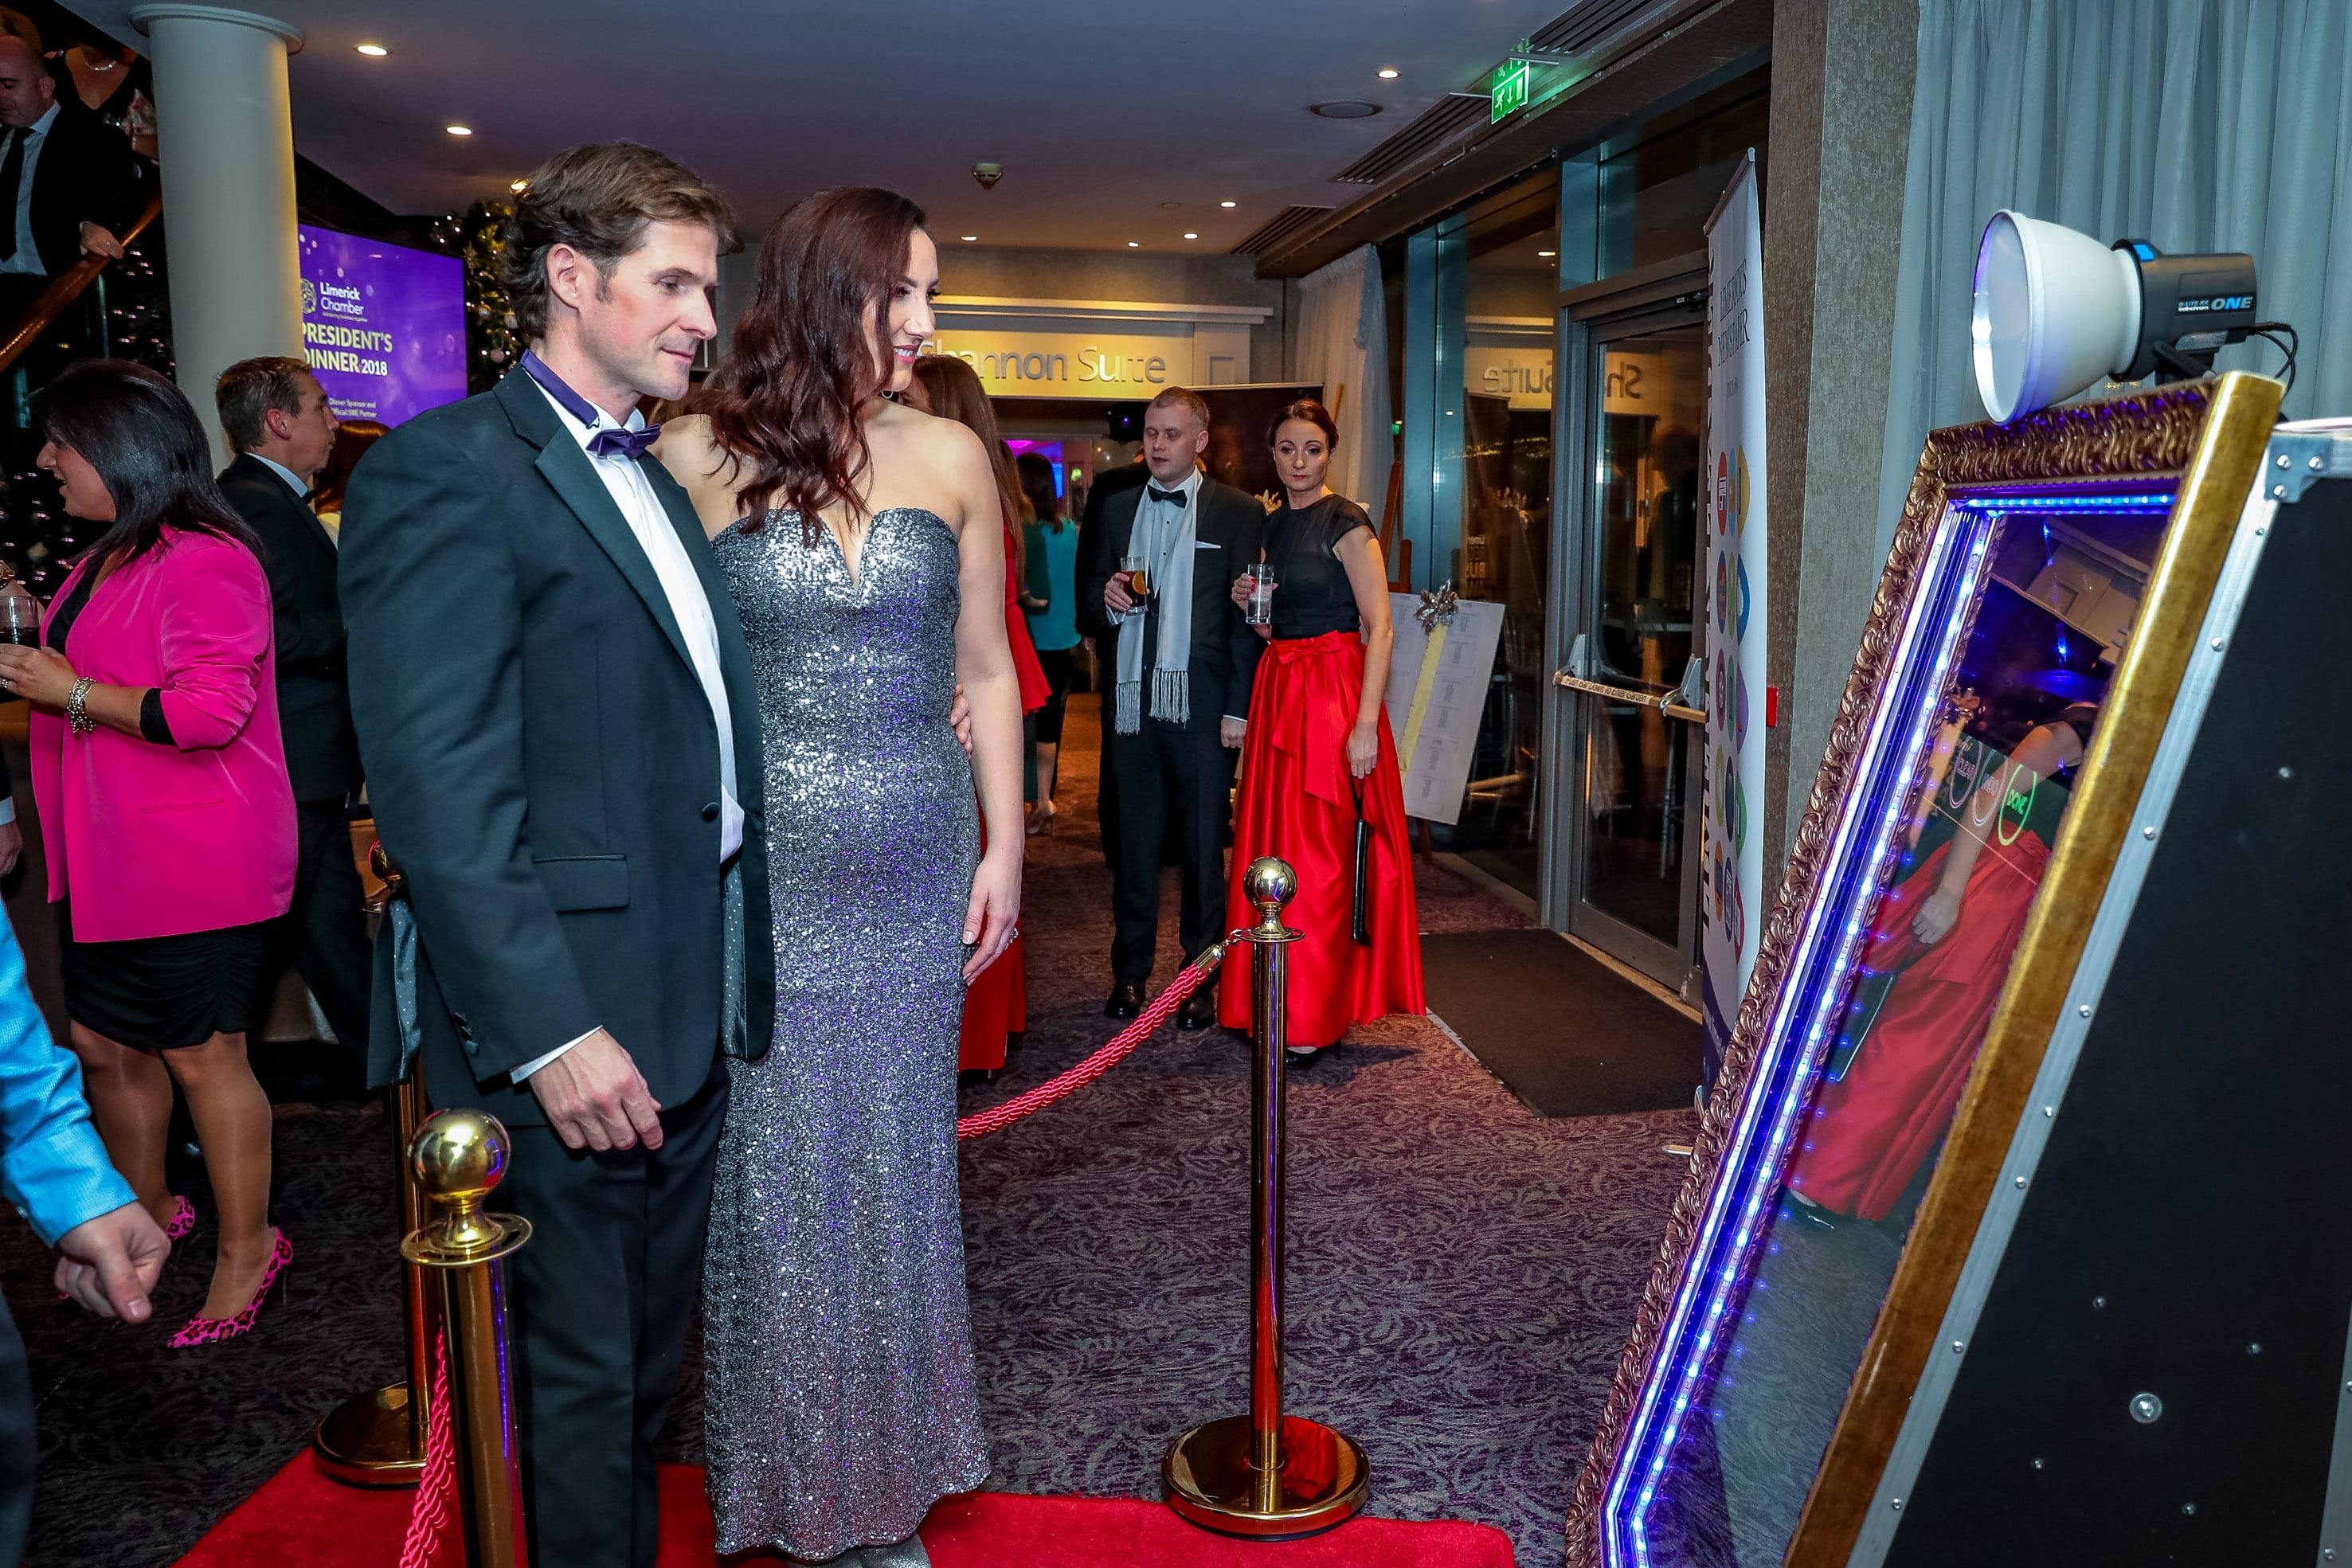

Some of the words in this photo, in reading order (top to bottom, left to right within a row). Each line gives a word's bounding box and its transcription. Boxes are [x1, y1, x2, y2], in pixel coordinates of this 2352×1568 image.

[320, 281, 361, 300] Limerick
[321, 296, 365, 315] Chamber
[2211, 296, 2252, 311] ONE
[361, 358, 388, 377] 2018
[1078, 345, 1166, 383] Suite
[2006, 788, 2029, 815] DONE
